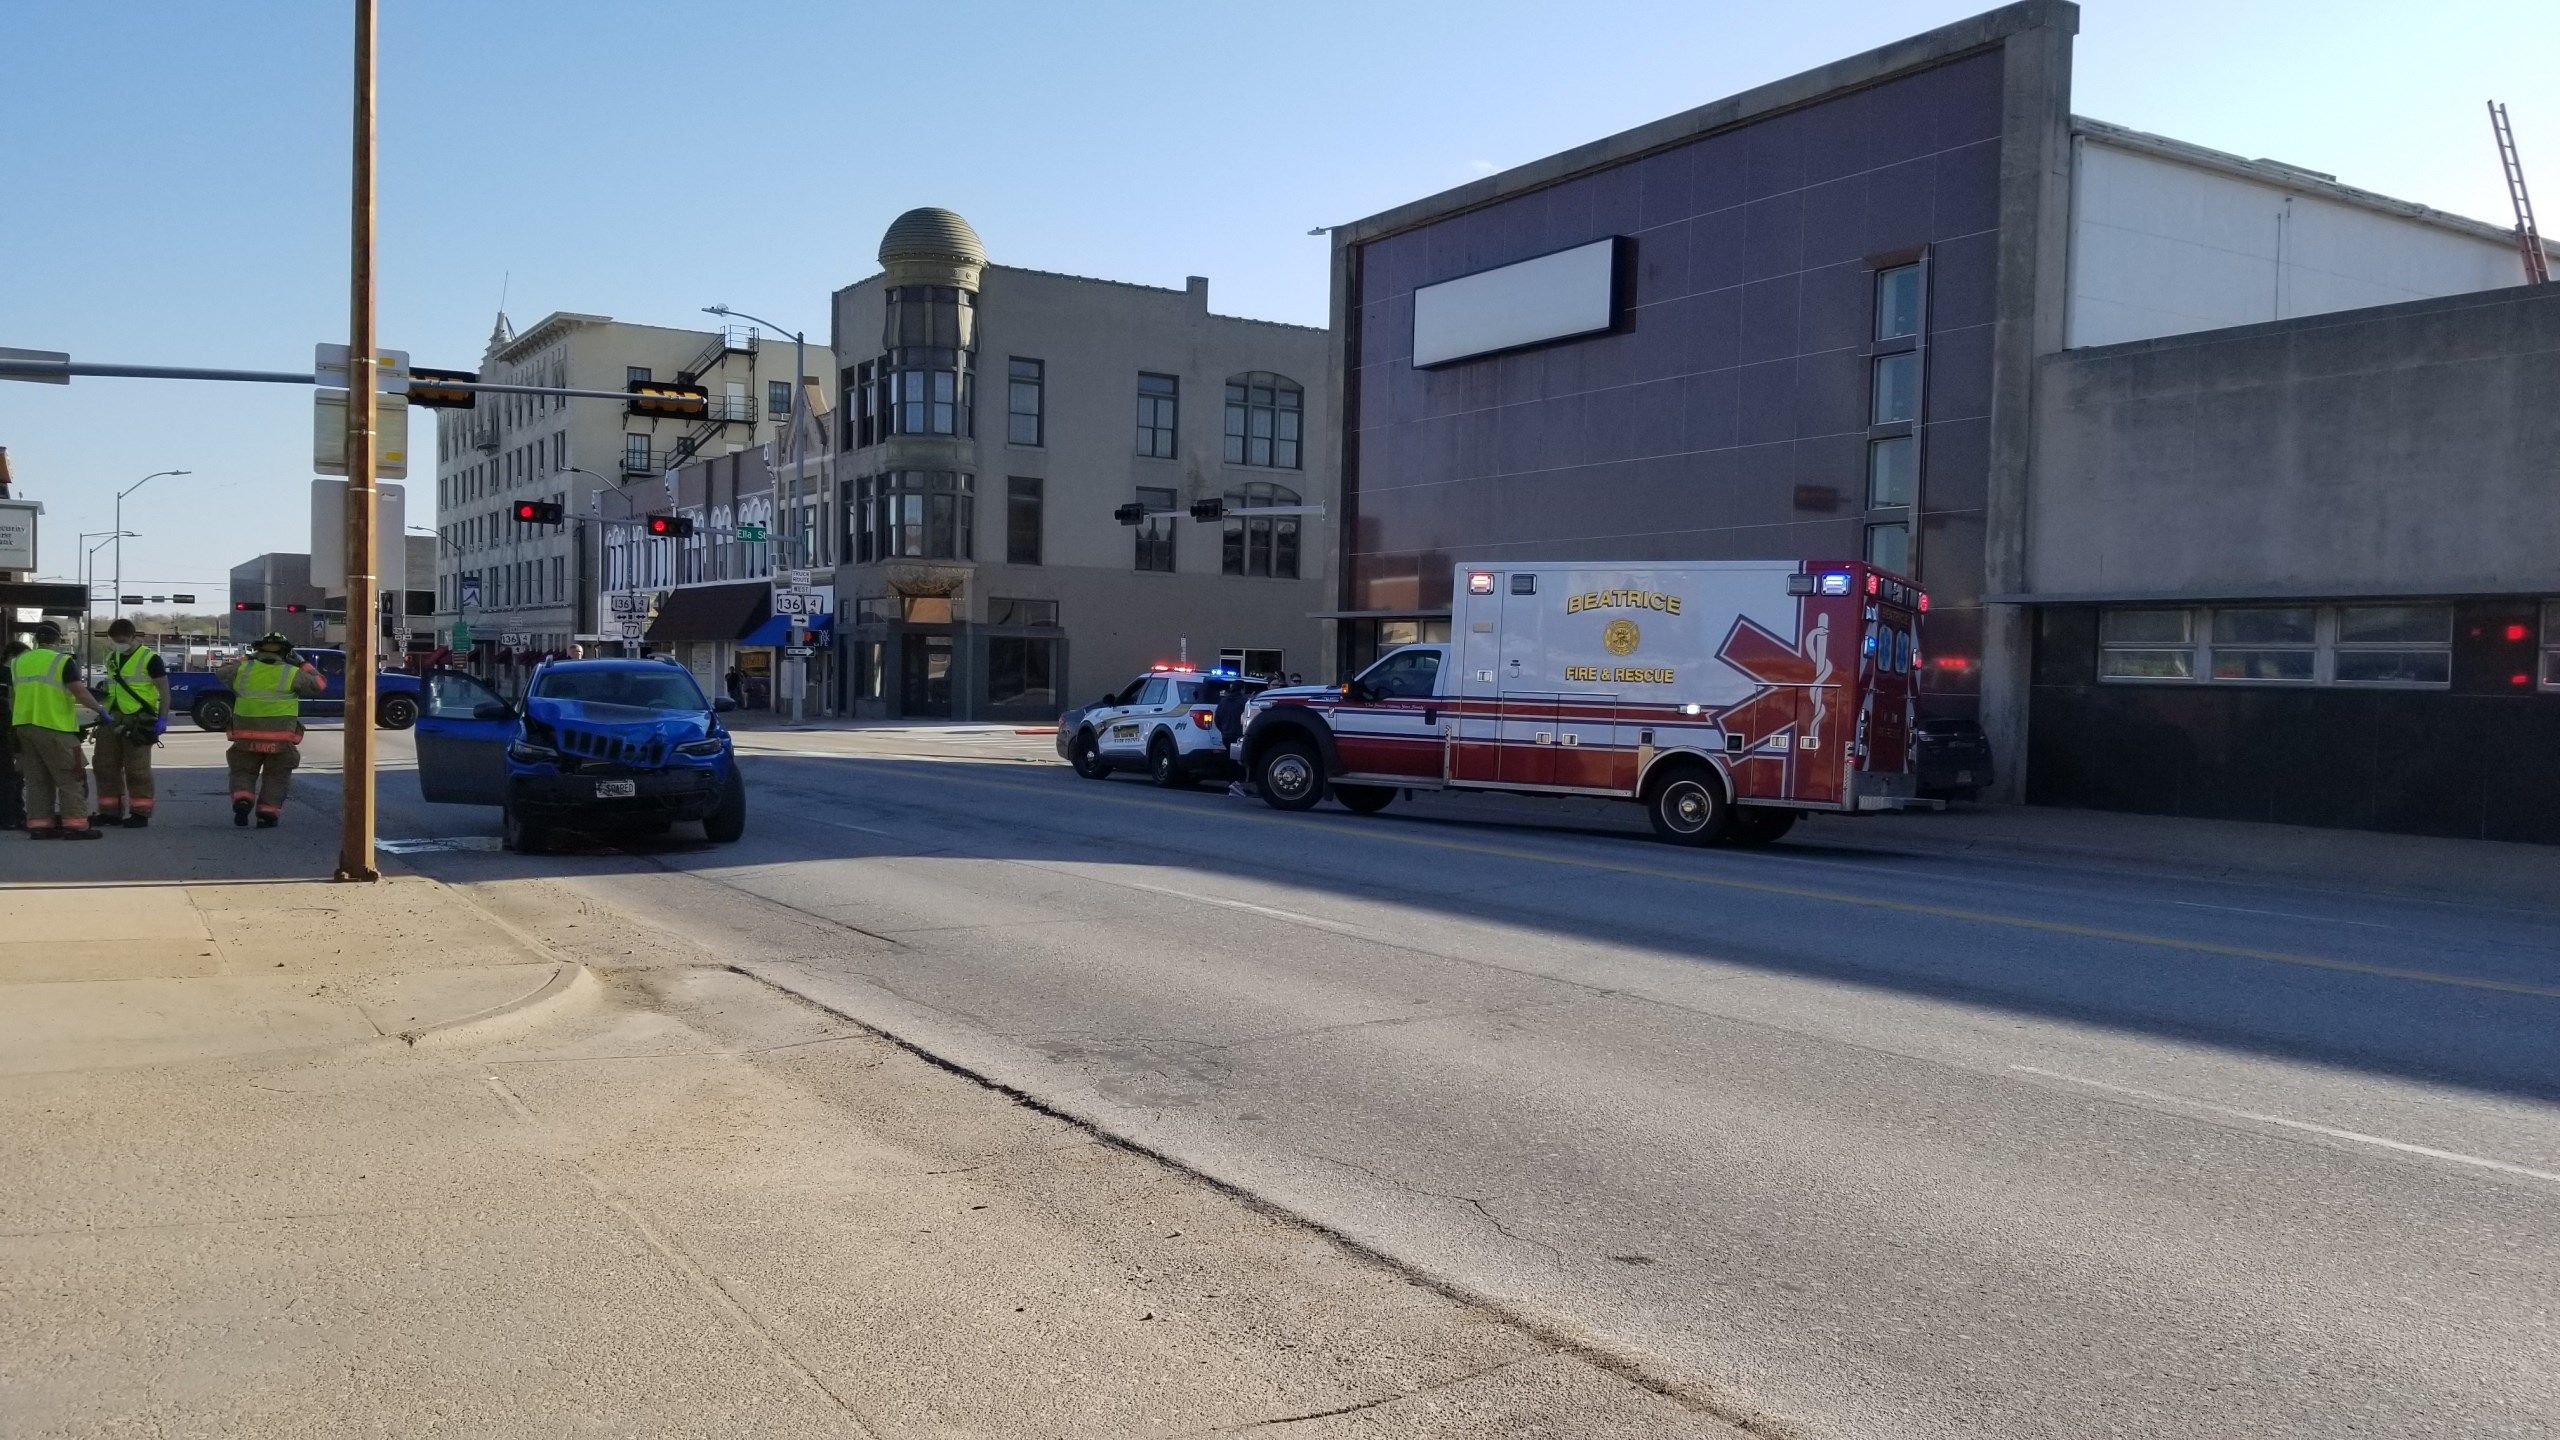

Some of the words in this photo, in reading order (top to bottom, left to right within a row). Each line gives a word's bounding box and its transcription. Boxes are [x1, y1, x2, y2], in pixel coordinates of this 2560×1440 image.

[738, 530, 752, 539] Ella
[758, 531, 766, 540] St
[614, 599, 630, 609] 136
[779, 598, 800, 610] 136
[1567, 590, 1682, 616] BEATRICE
[624, 625, 637, 635] 77
[502, 635, 517, 643] 136
[1565, 667, 1597, 681] FIRE
[1600, 668, 1611, 681] &
[1614, 667, 1674, 683] RESCUE
